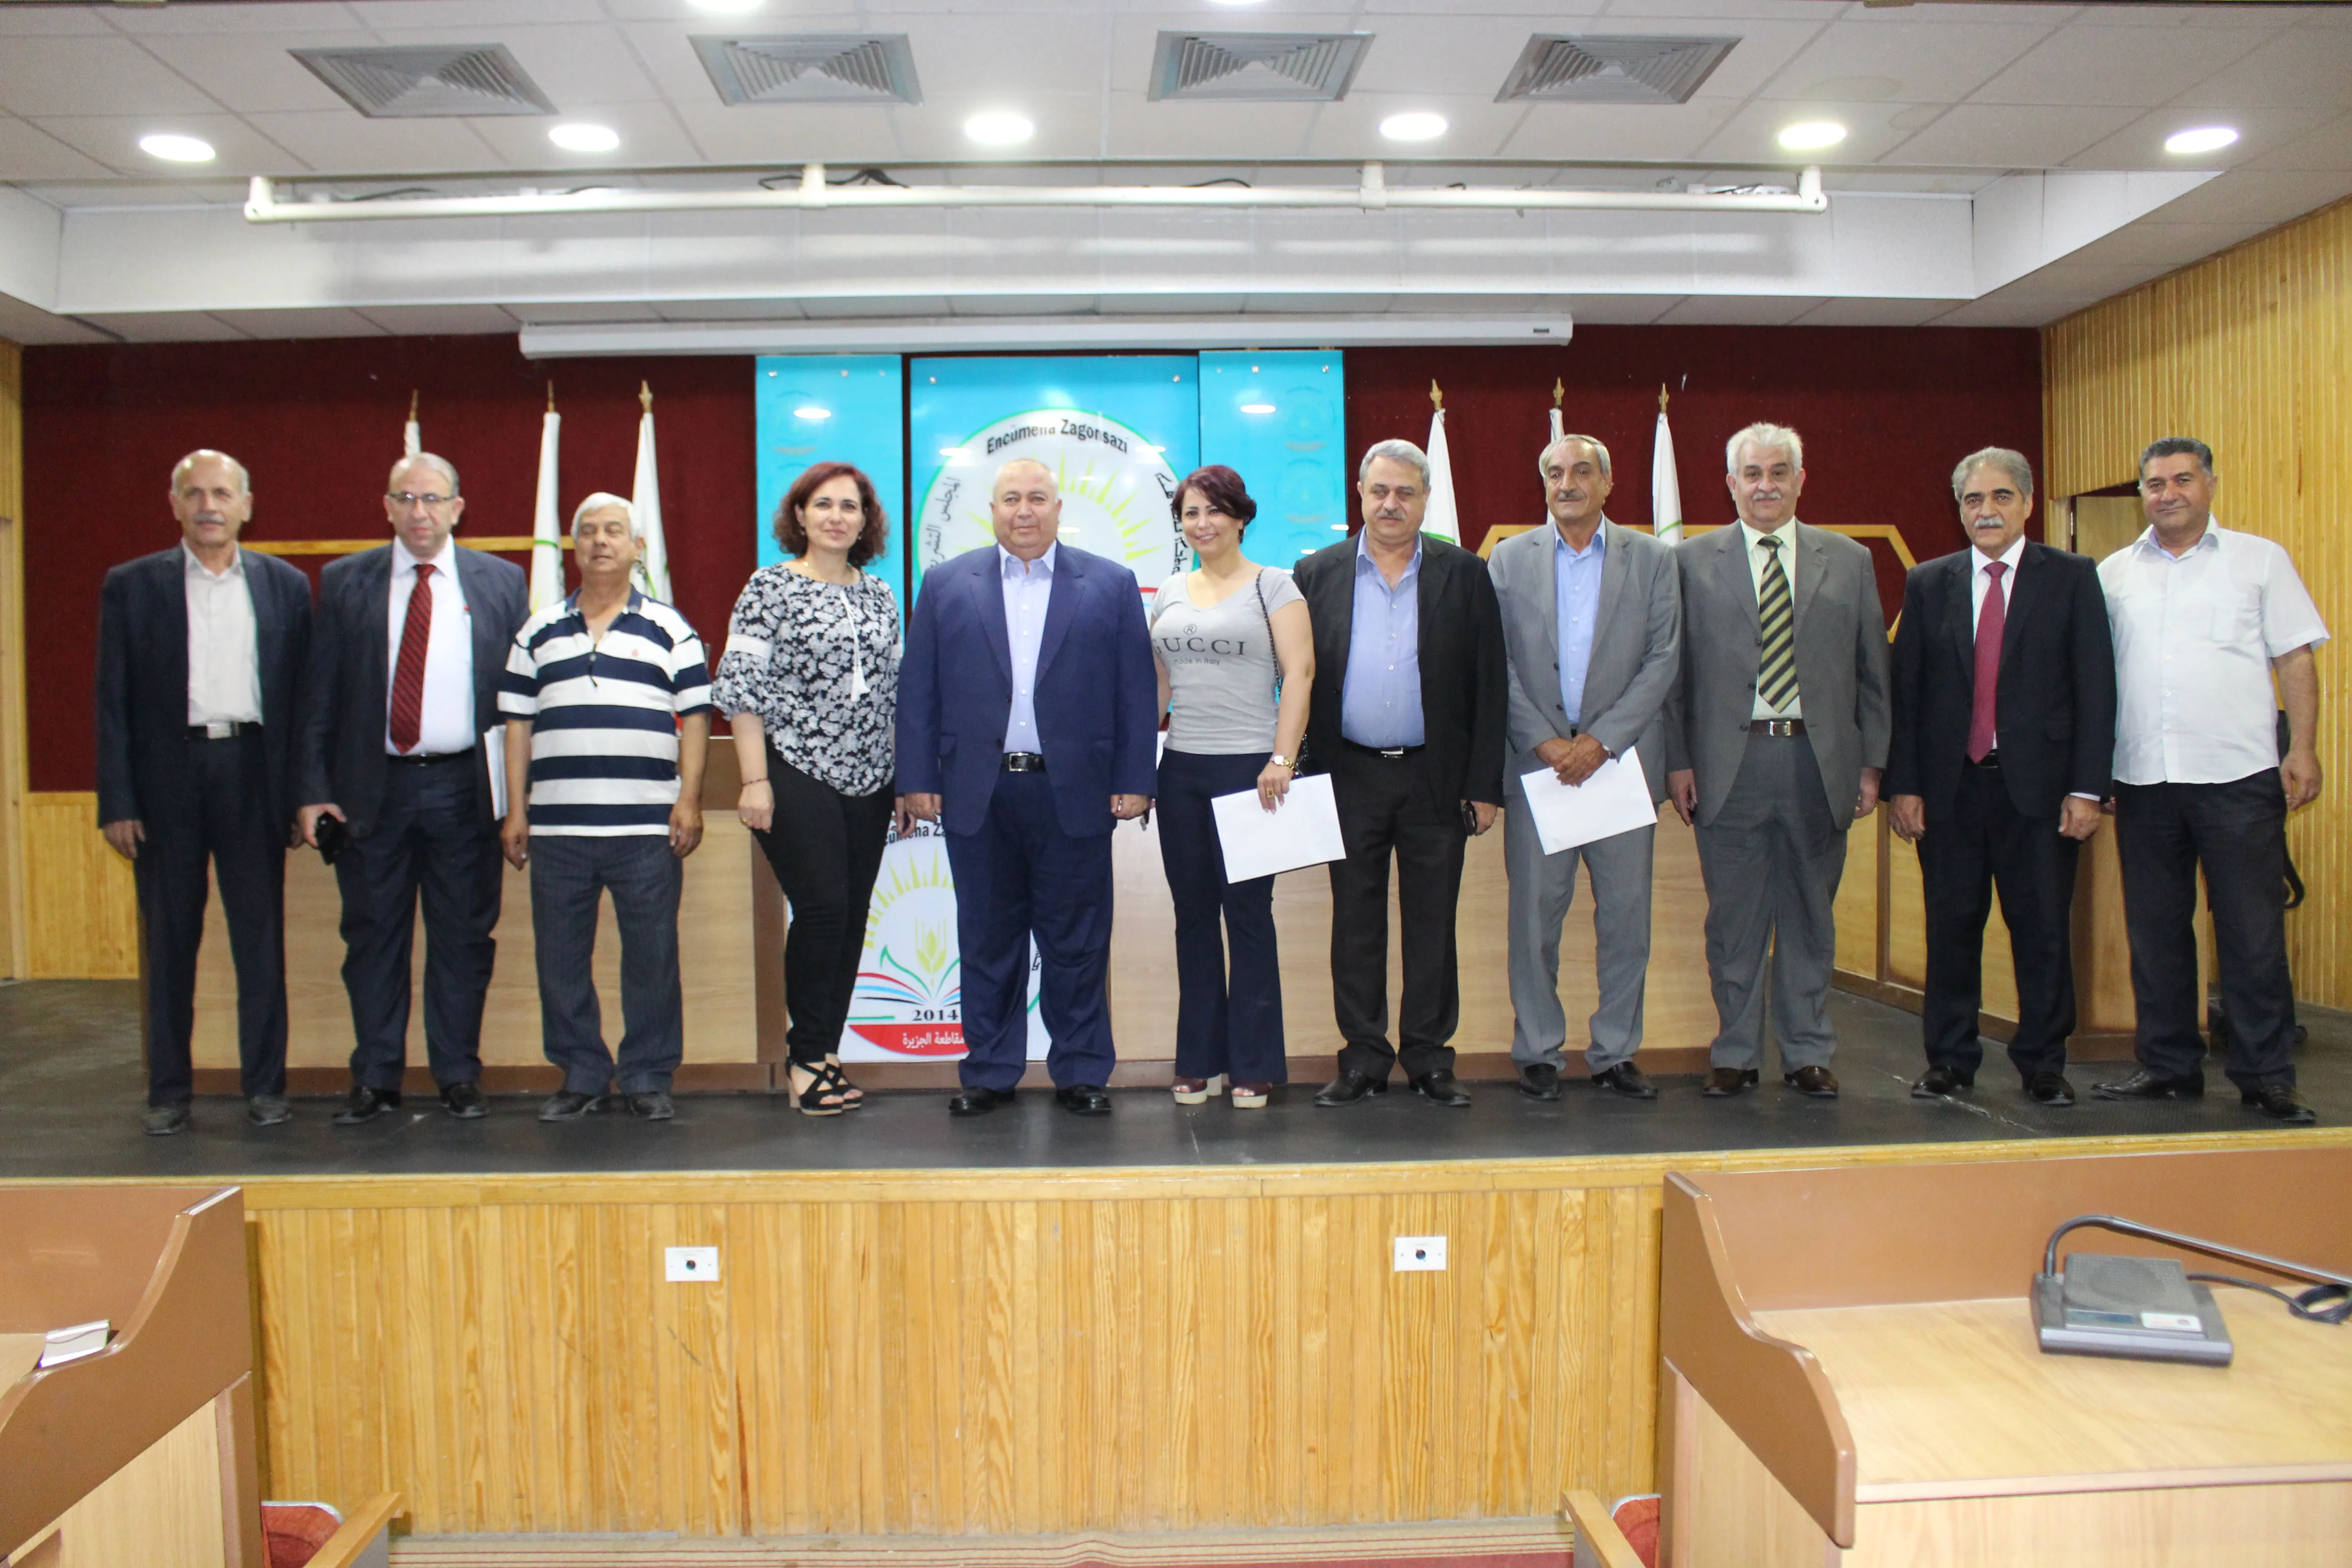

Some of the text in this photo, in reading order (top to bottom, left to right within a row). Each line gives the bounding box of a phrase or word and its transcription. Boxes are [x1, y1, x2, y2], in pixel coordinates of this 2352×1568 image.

[934, 477, 961, 521] المجلس
[912, 1009, 959, 1021] 2014
[902, 1031, 965, 1049] مقاطعة الجزيرة
